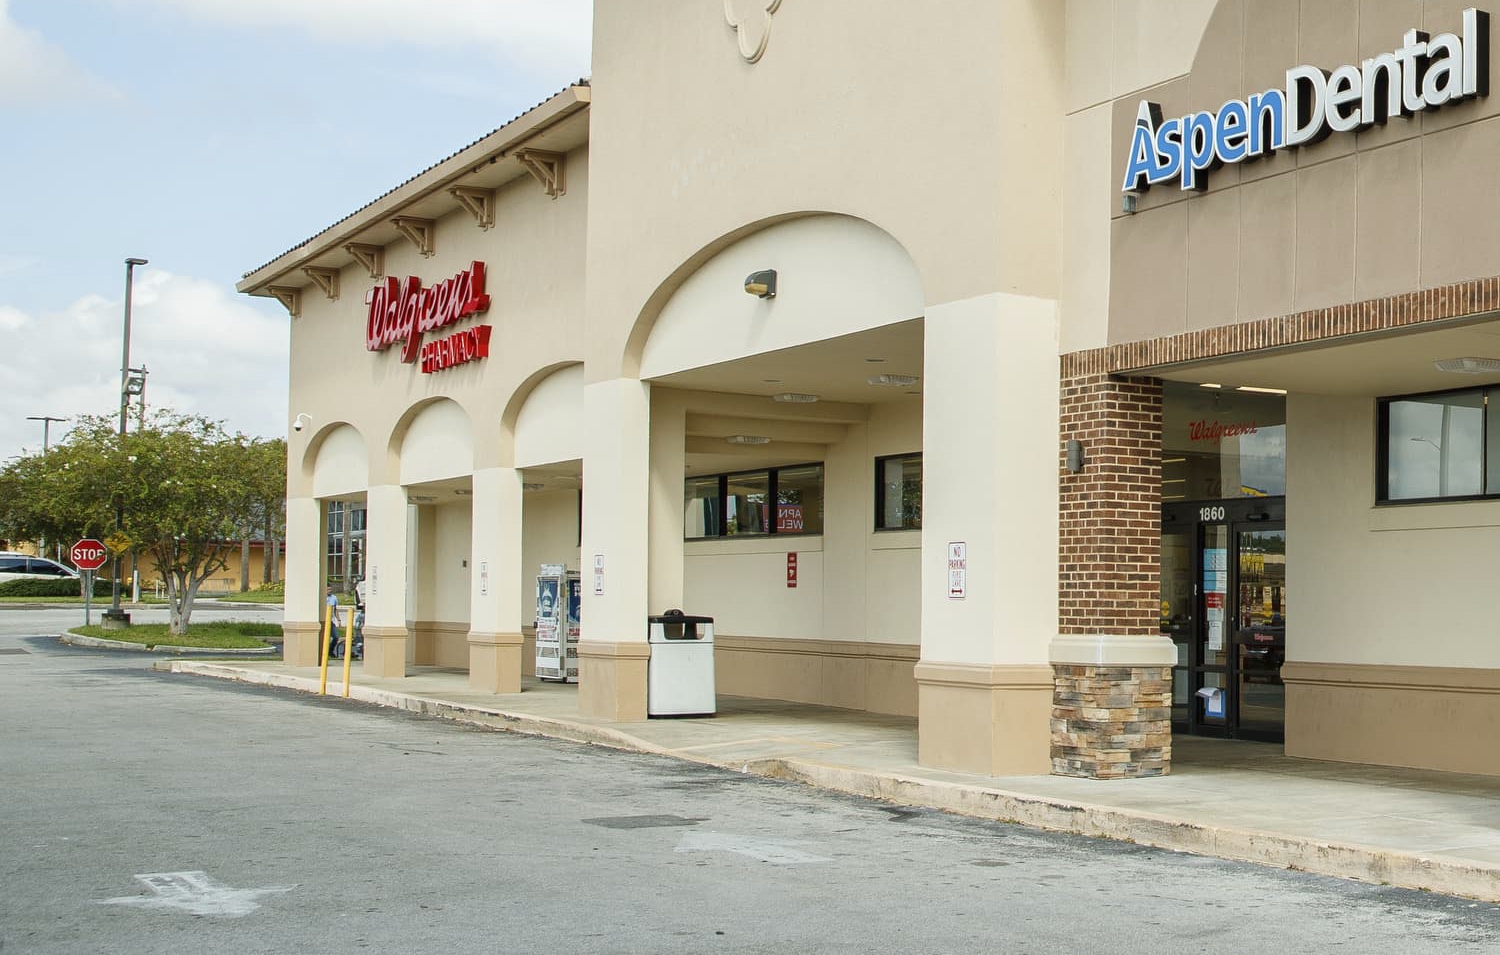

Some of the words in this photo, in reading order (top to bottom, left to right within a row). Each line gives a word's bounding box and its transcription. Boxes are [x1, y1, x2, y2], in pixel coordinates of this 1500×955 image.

[365, 260, 490, 364] Walgreens
[421, 325, 491, 373] PHARMACY
[1189, 420, 1257, 446] Walgreens
[1199, 506, 1225, 521] 1860
